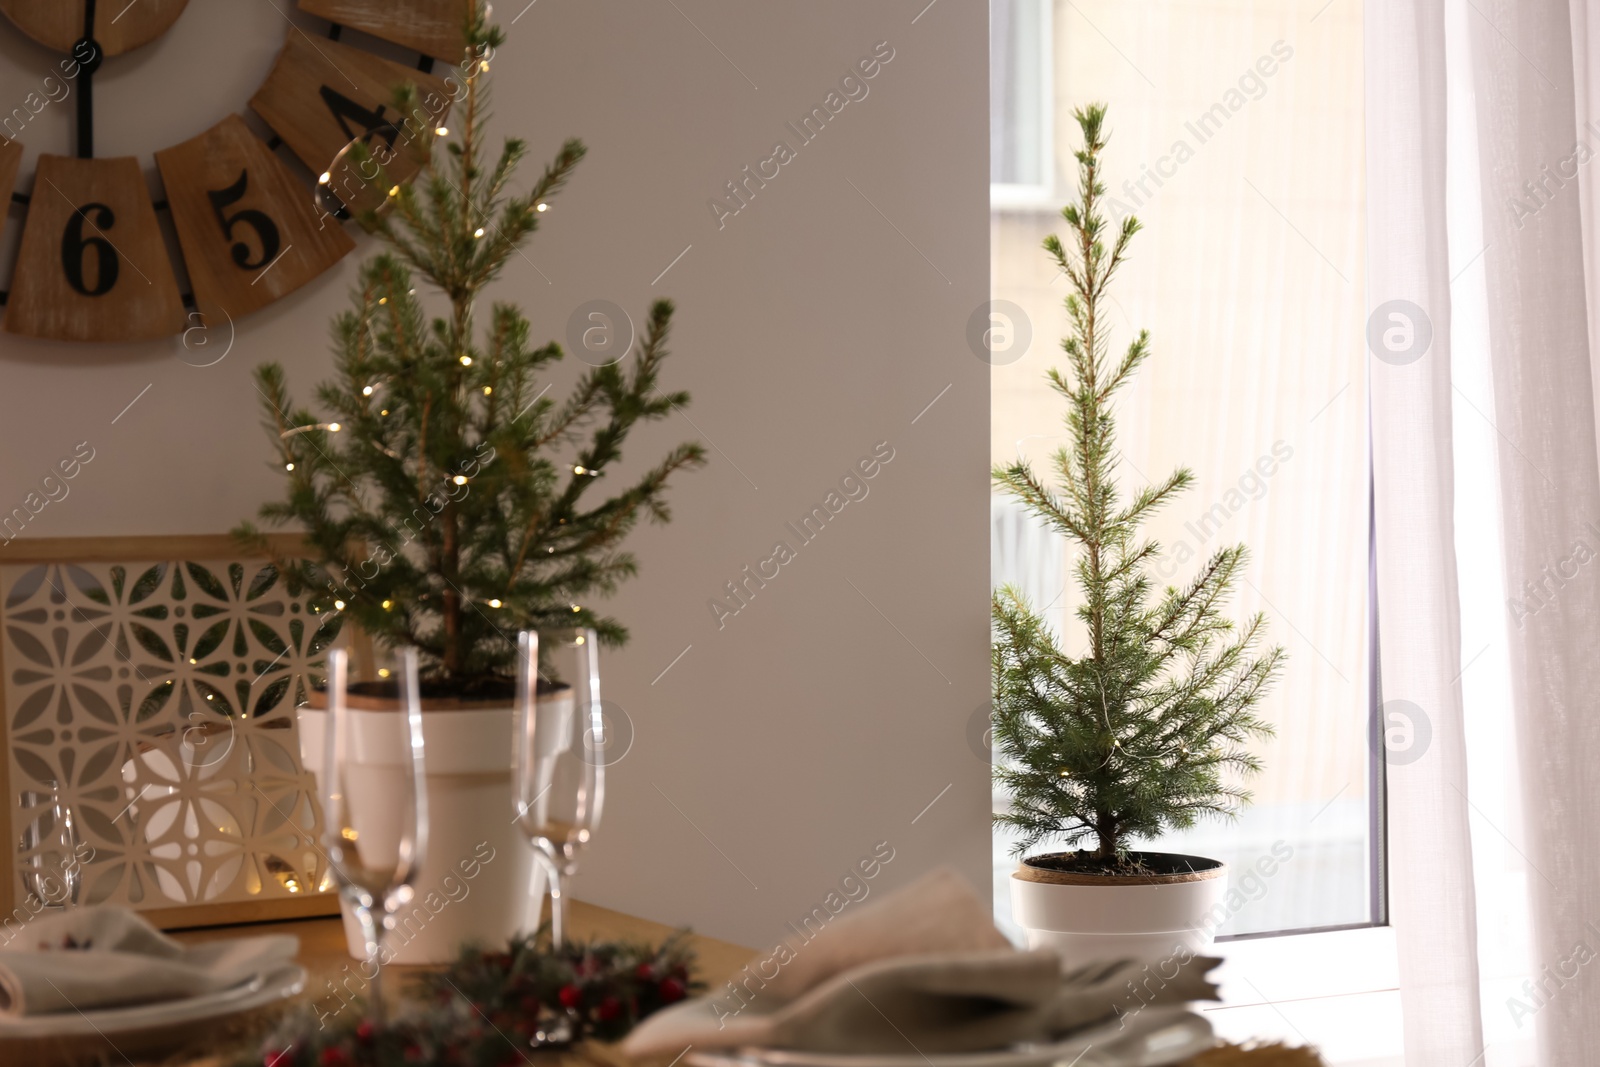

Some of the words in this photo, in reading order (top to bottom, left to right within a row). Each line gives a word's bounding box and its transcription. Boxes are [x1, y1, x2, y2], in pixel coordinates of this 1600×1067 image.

[320, 84, 405, 151] 4
[61, 203, 119, 297] 6
[207, 168, 281, 271] 5
